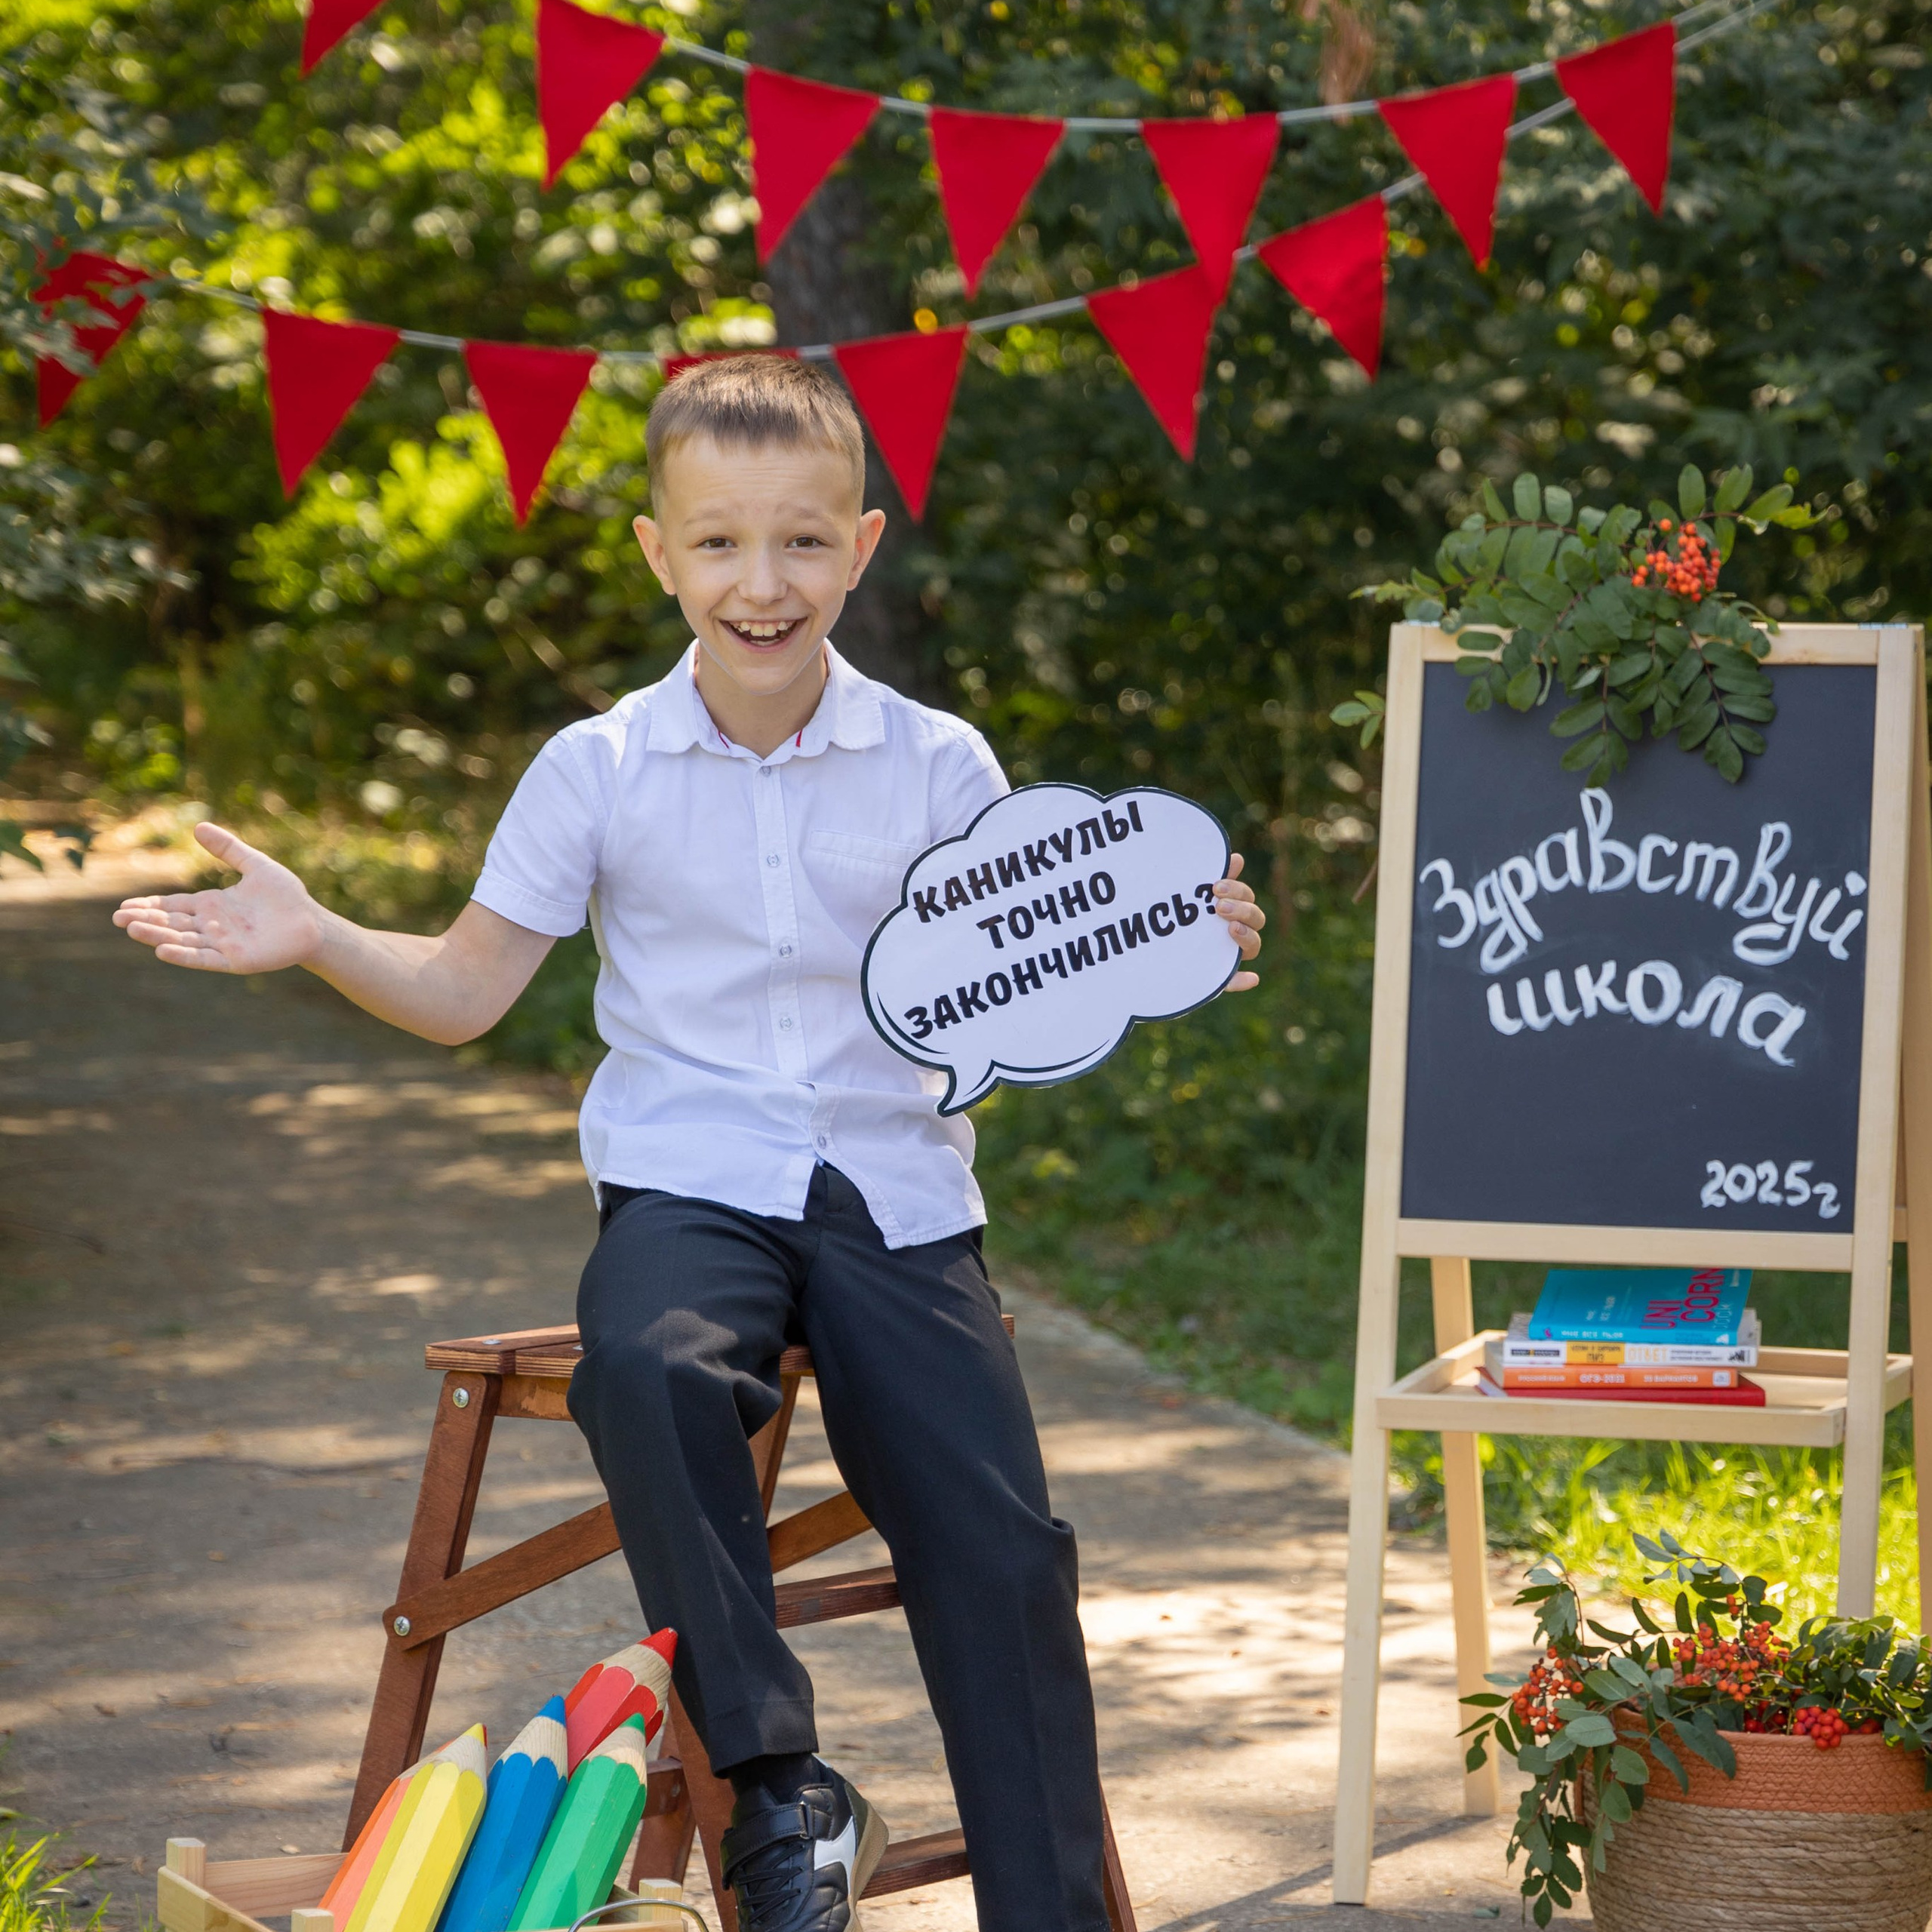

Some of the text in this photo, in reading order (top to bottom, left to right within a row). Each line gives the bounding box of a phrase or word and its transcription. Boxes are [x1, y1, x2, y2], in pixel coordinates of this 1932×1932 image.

[913, 801, 1144, 923] КАНИКУЛЫ
[976, 871, 1116, 949] ТОЧНО
[1420, 786, 1867, 974] Здравствуй
[904, 883, 1216, 1039] ЗАКОНЧИЛИСЬ?
[1487, 960, 1806, 1067] школа
[1640, 1300, 1682, 1330] UNI
[1679, 1267, 1725, 1323] CORN
